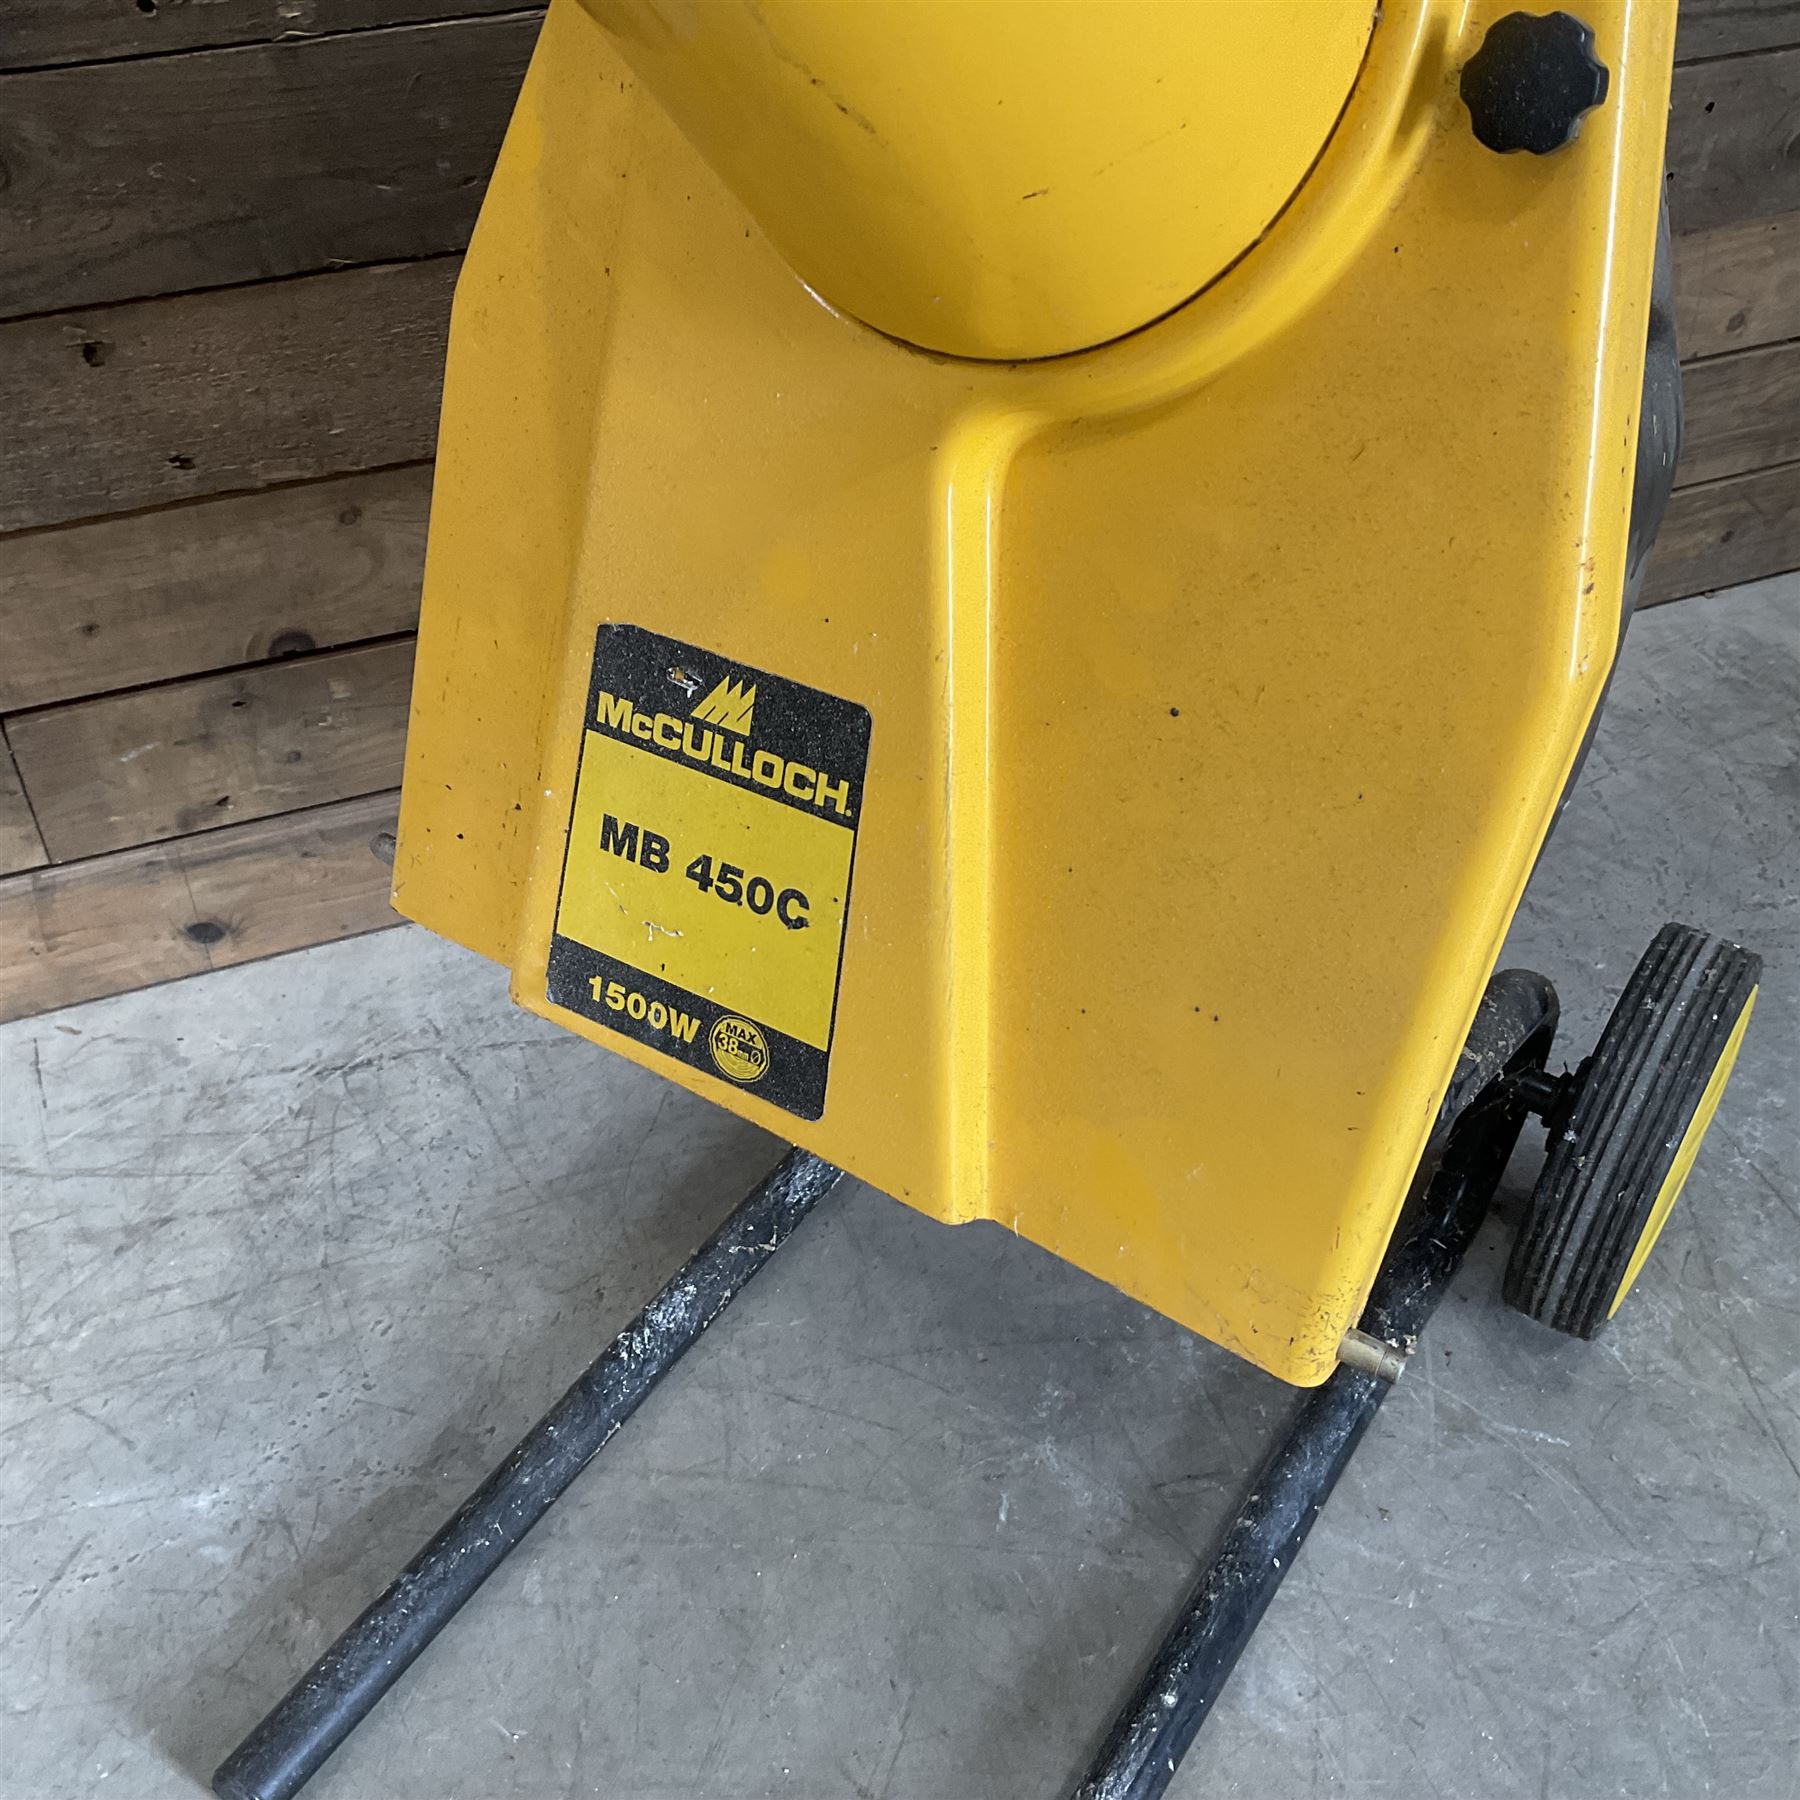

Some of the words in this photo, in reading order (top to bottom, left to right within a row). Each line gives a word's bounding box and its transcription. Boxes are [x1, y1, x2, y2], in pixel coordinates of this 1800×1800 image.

[600, 813, 670, 873] MB
[685, 854, 810, 930] 450C
[588, 975, 701, 1043] 1500W
[725, 1022, 757, 1045] MAX
